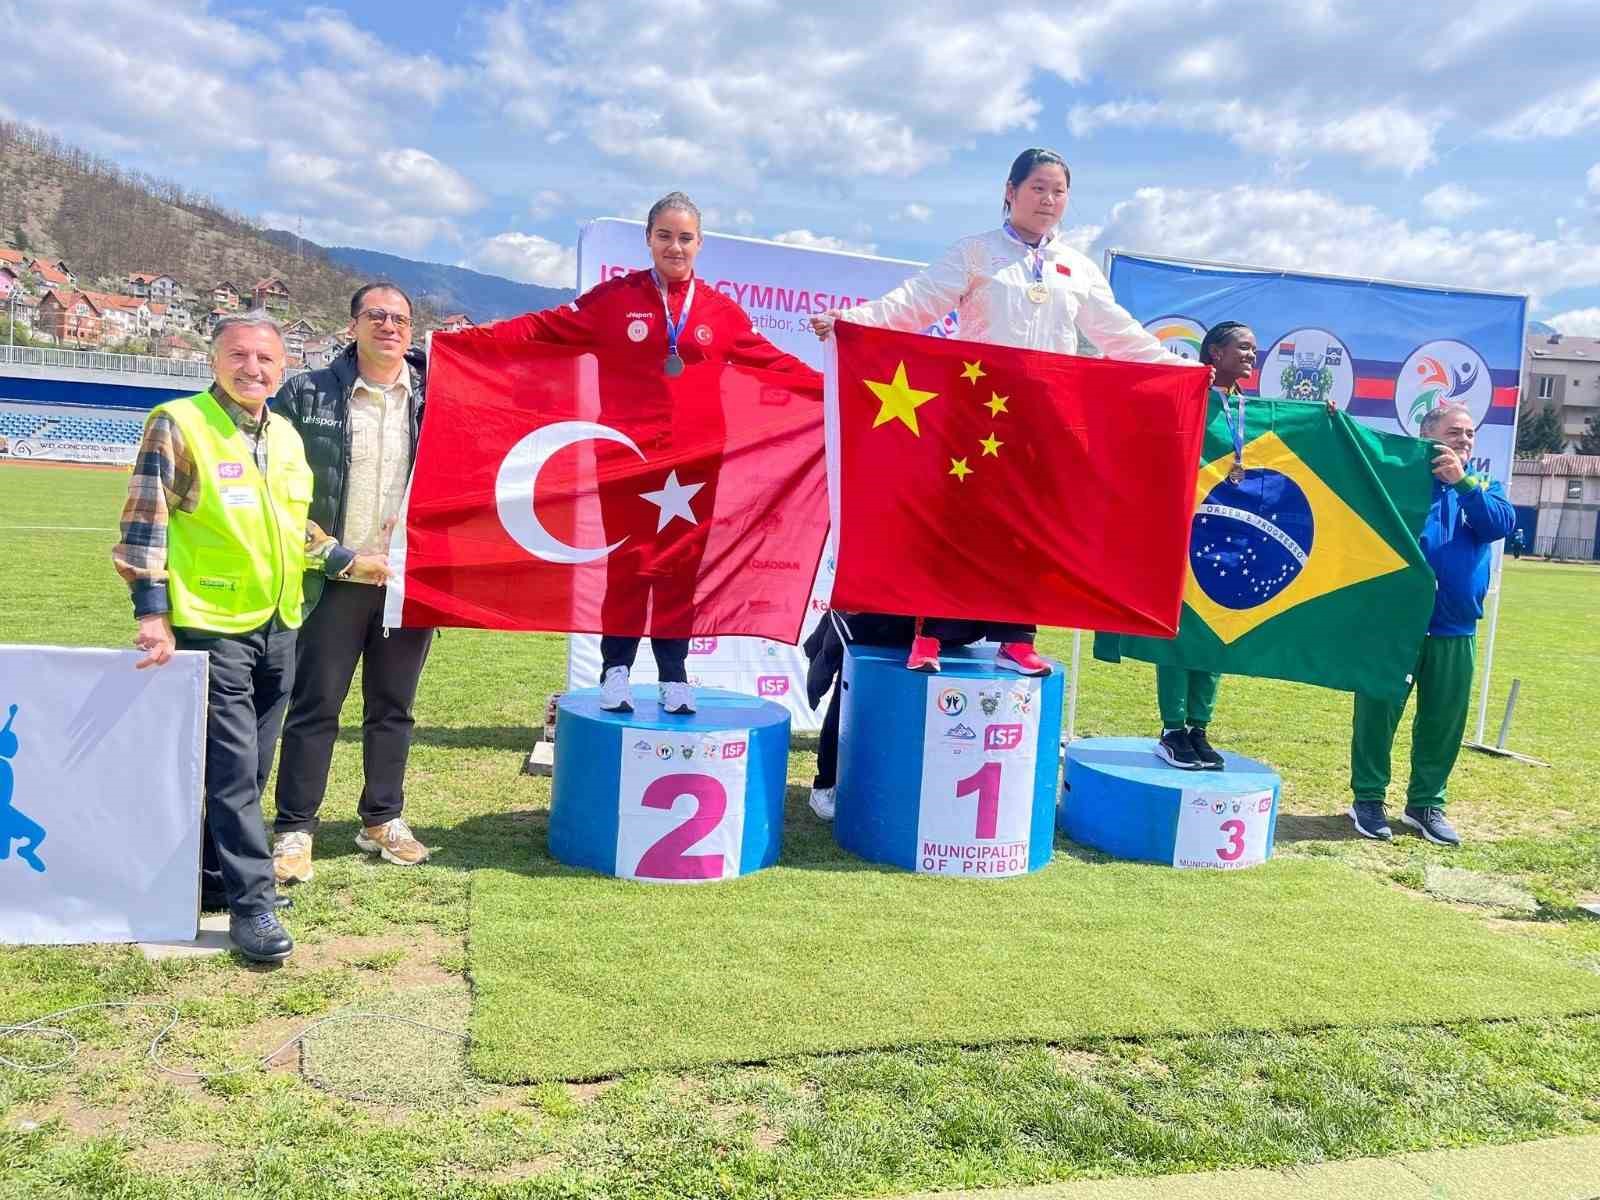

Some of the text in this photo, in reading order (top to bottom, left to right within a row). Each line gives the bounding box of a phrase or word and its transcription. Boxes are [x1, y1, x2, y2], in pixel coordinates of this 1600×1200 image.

[715, 280, 869, 315] GYMNASIA
[689, 637, 714, 650] ISF
[761, 682, 786, 693] ISF
[989, 728, 1019, 745] ISF
[725, 744, 744, 757] ISF
[956, 762, 1002, 839] 1
[634, 773, 728, 880] 2
[1216, 820, 1245, 861] 3
[923, 842, 1028, 859] MUNICIPALITY
[922, 858, 1027, 873] OF PRIBOJ
